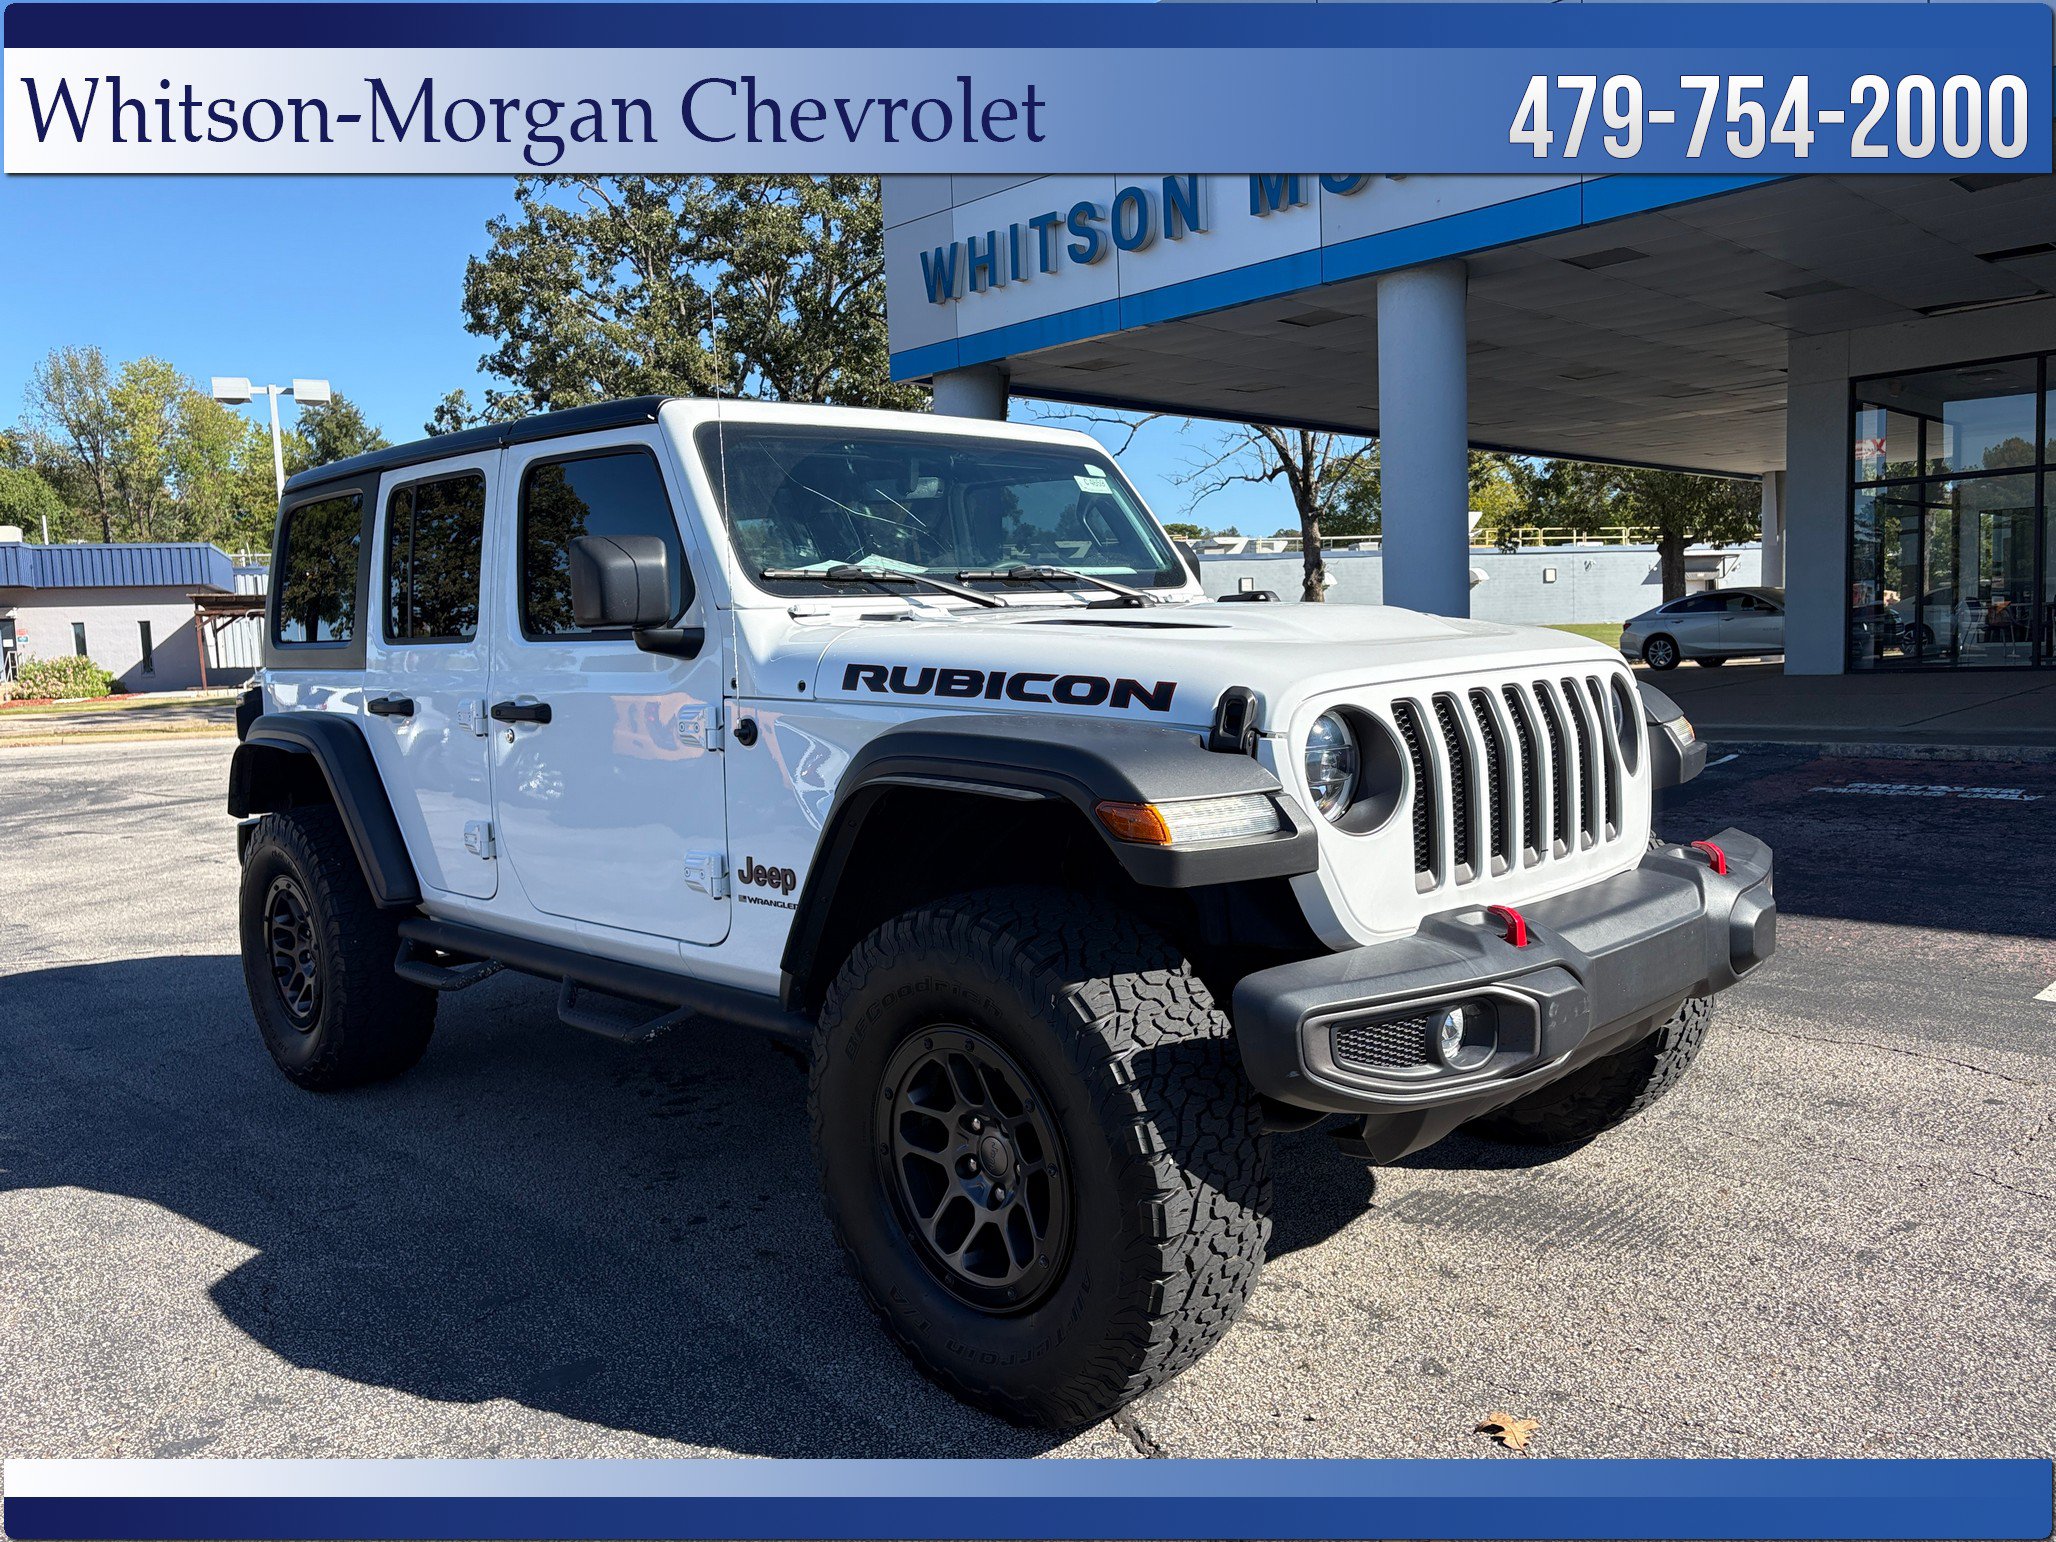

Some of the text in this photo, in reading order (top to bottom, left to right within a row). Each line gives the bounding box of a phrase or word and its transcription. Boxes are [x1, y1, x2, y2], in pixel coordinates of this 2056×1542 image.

[920, 173, 1208, 304] WHITSON
[841, 663, 1177, 712] RUBICON
[737, 855, 797, 896] Jeep
